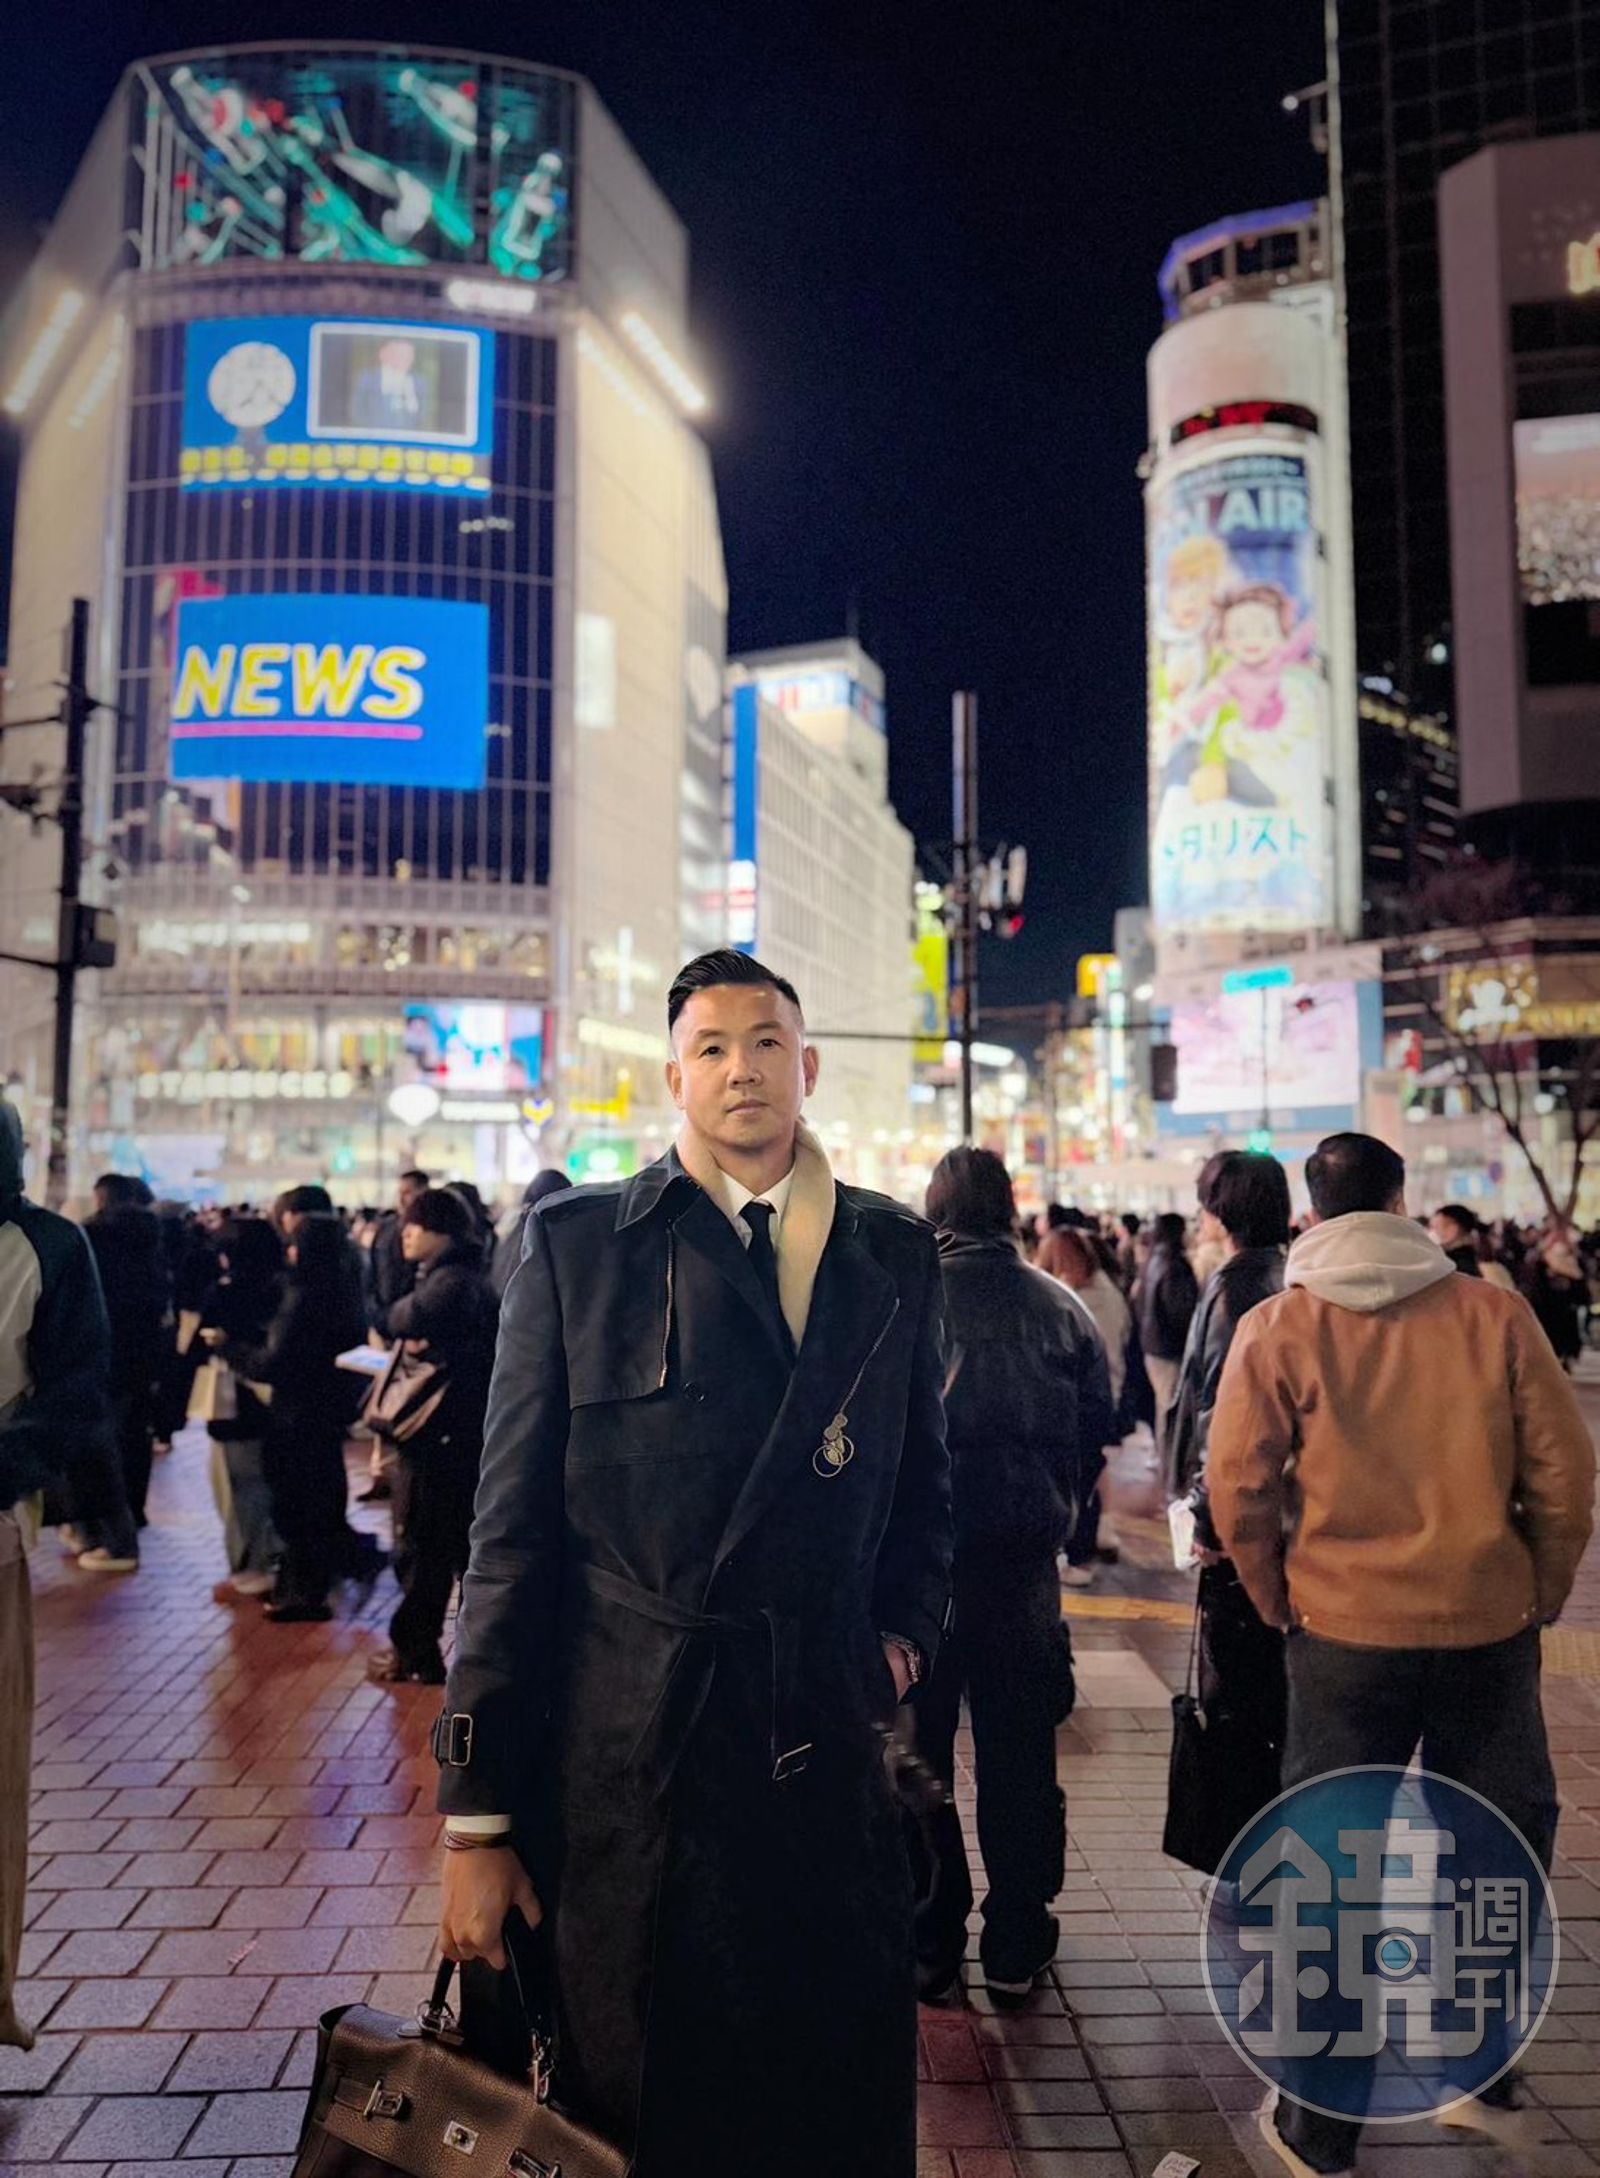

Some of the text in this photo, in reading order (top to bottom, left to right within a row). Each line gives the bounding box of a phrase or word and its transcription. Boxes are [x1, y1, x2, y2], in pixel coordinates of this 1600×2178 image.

[1217, 486, 1310, 534] AIR
[172, 642, 427, 720] NEWS
[1164, 816, 1309, 862] タリスト
